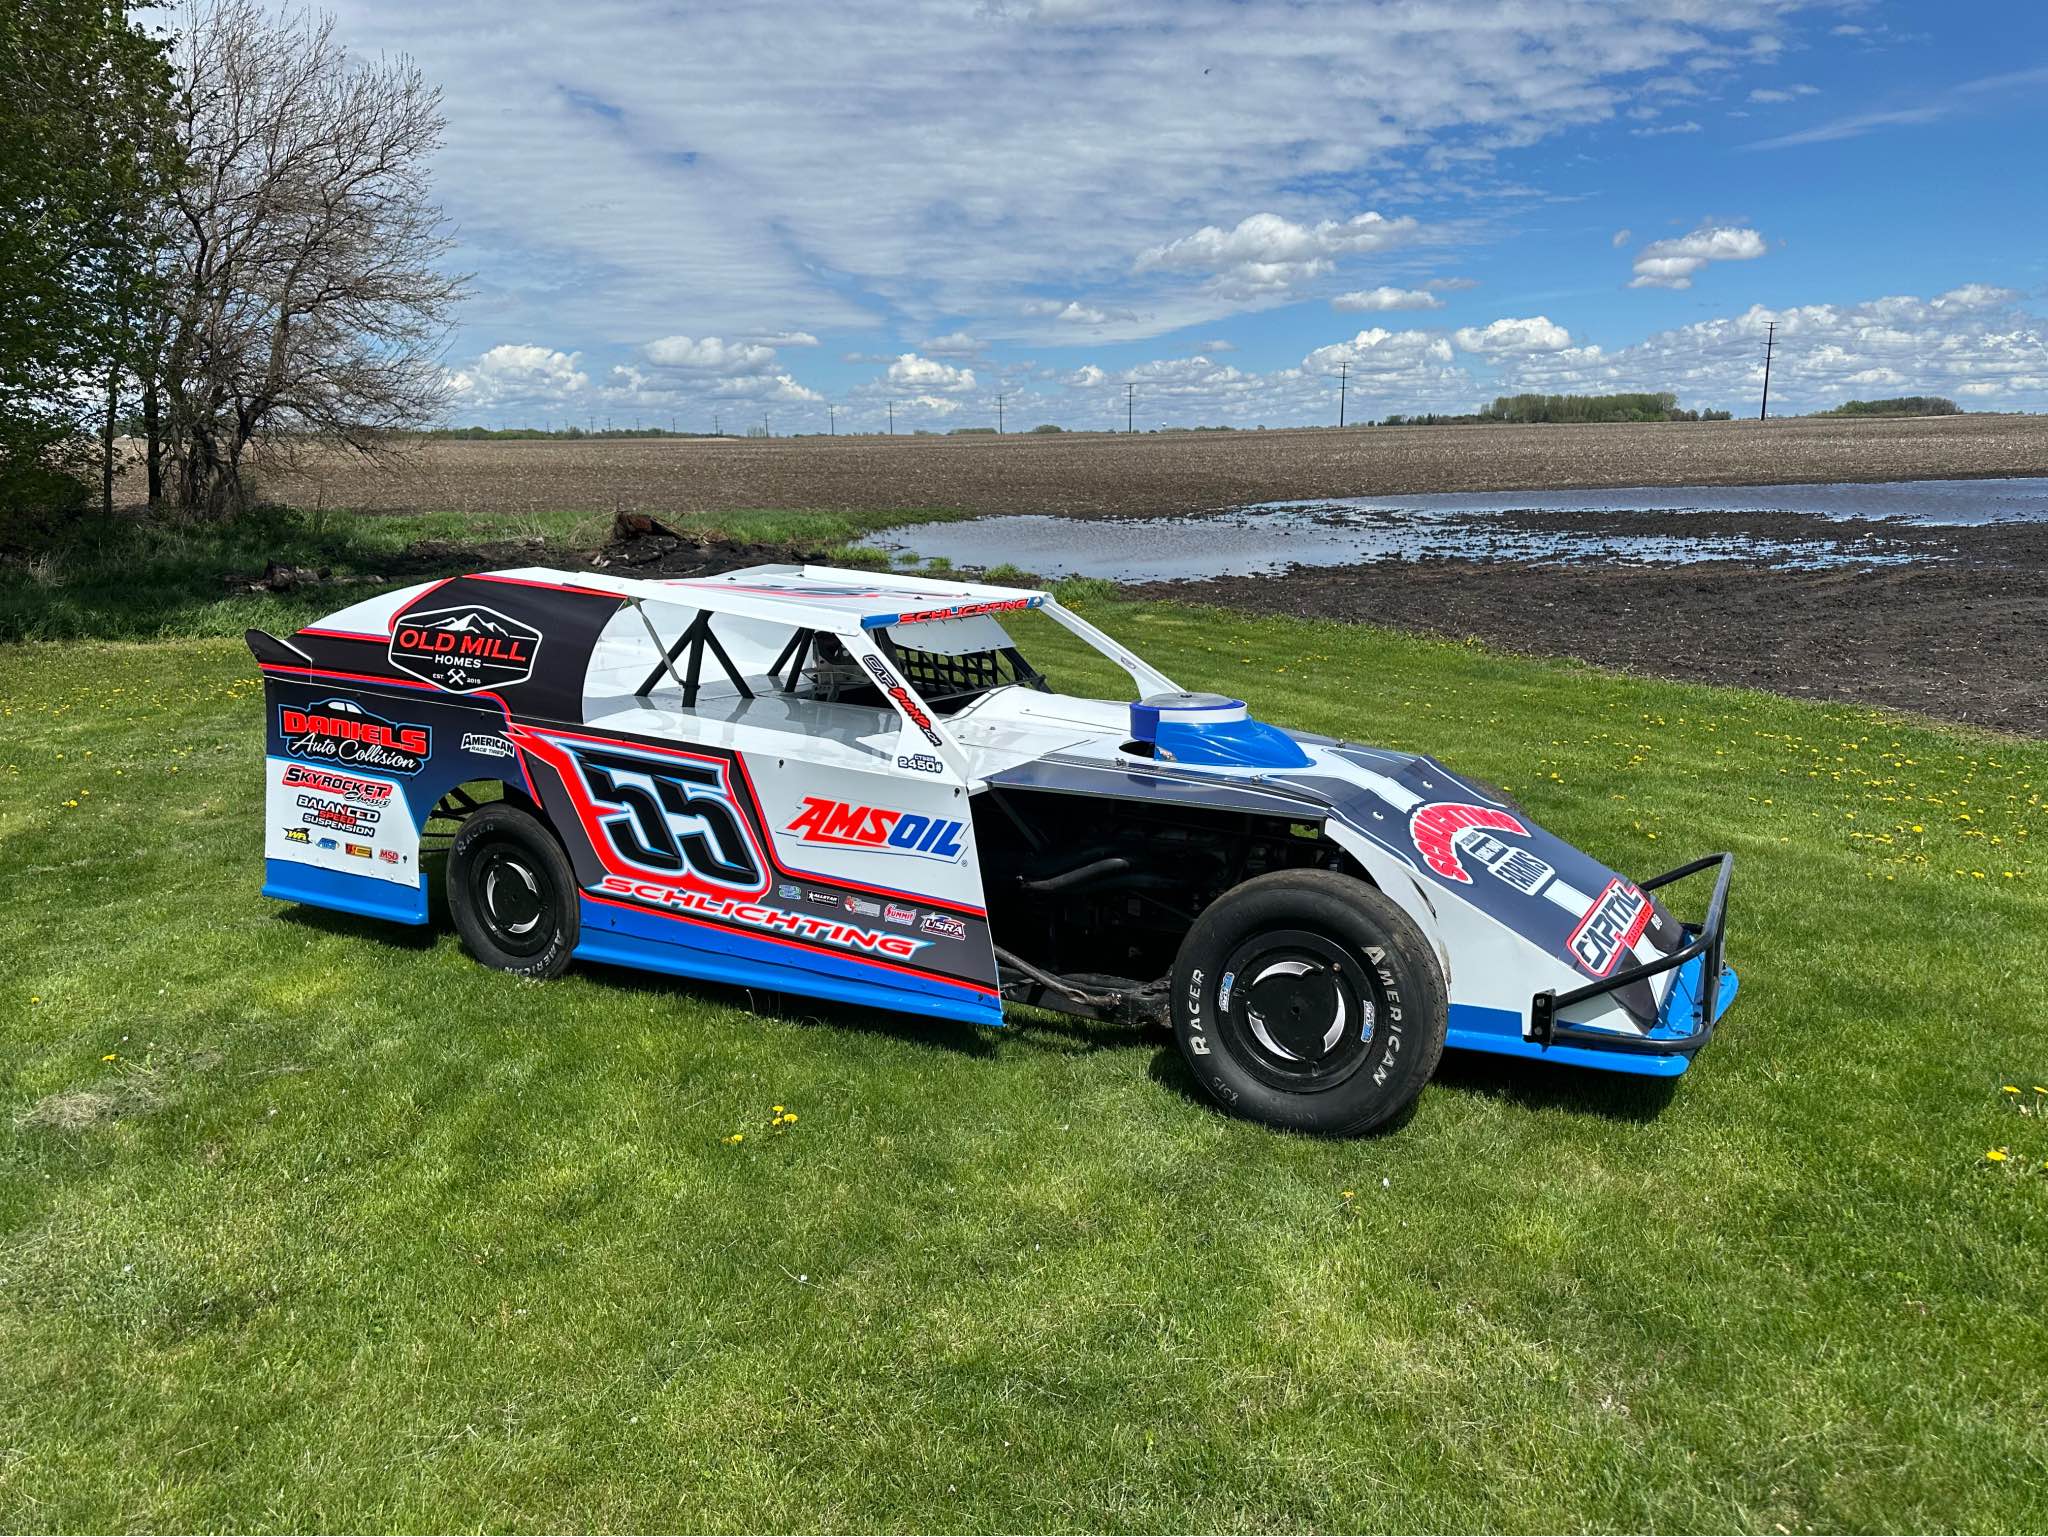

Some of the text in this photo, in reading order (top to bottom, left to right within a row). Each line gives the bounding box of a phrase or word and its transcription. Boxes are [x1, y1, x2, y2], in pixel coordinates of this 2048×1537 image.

[900, 598, 1029, 625] SCHLICHTING
[399, 629, 527, 662] OLD MILL
[434, 654, 482, 669] HOMES
[283, 710, 426, 755] DANIELS
[463, 734, 513, 756] AMERICAN
[291, 732, 417, 769] Auto Collision
[898, 757, 943, 772] 2450#
[285, 767, 388, 798] SKYROCKET
[298, 795, 379, 822] BALANCED
[319, 808, 356, 825] SPEED
[566, 744, 760, 886] 55
[304, 813, 374, 837] SUSPENSION
[785, 796, 964, 857] AMSOIL
[380, 850, 399, 862] MSD
[1495, 851, 1548, 891] FARMS
[813, 893, 838, 902] ALLSTAR
[886, 905, 914, 919] SUMMIT
[601, 876, 918, 957] SCHLICHTING
[925, 919, 963, 935] USRA
[1576, 886, 1641, 970] CAPITAL
[1189, 968, 1212, 1057] RACER
[1361, 945, 1401, 1088] AMERICAN
